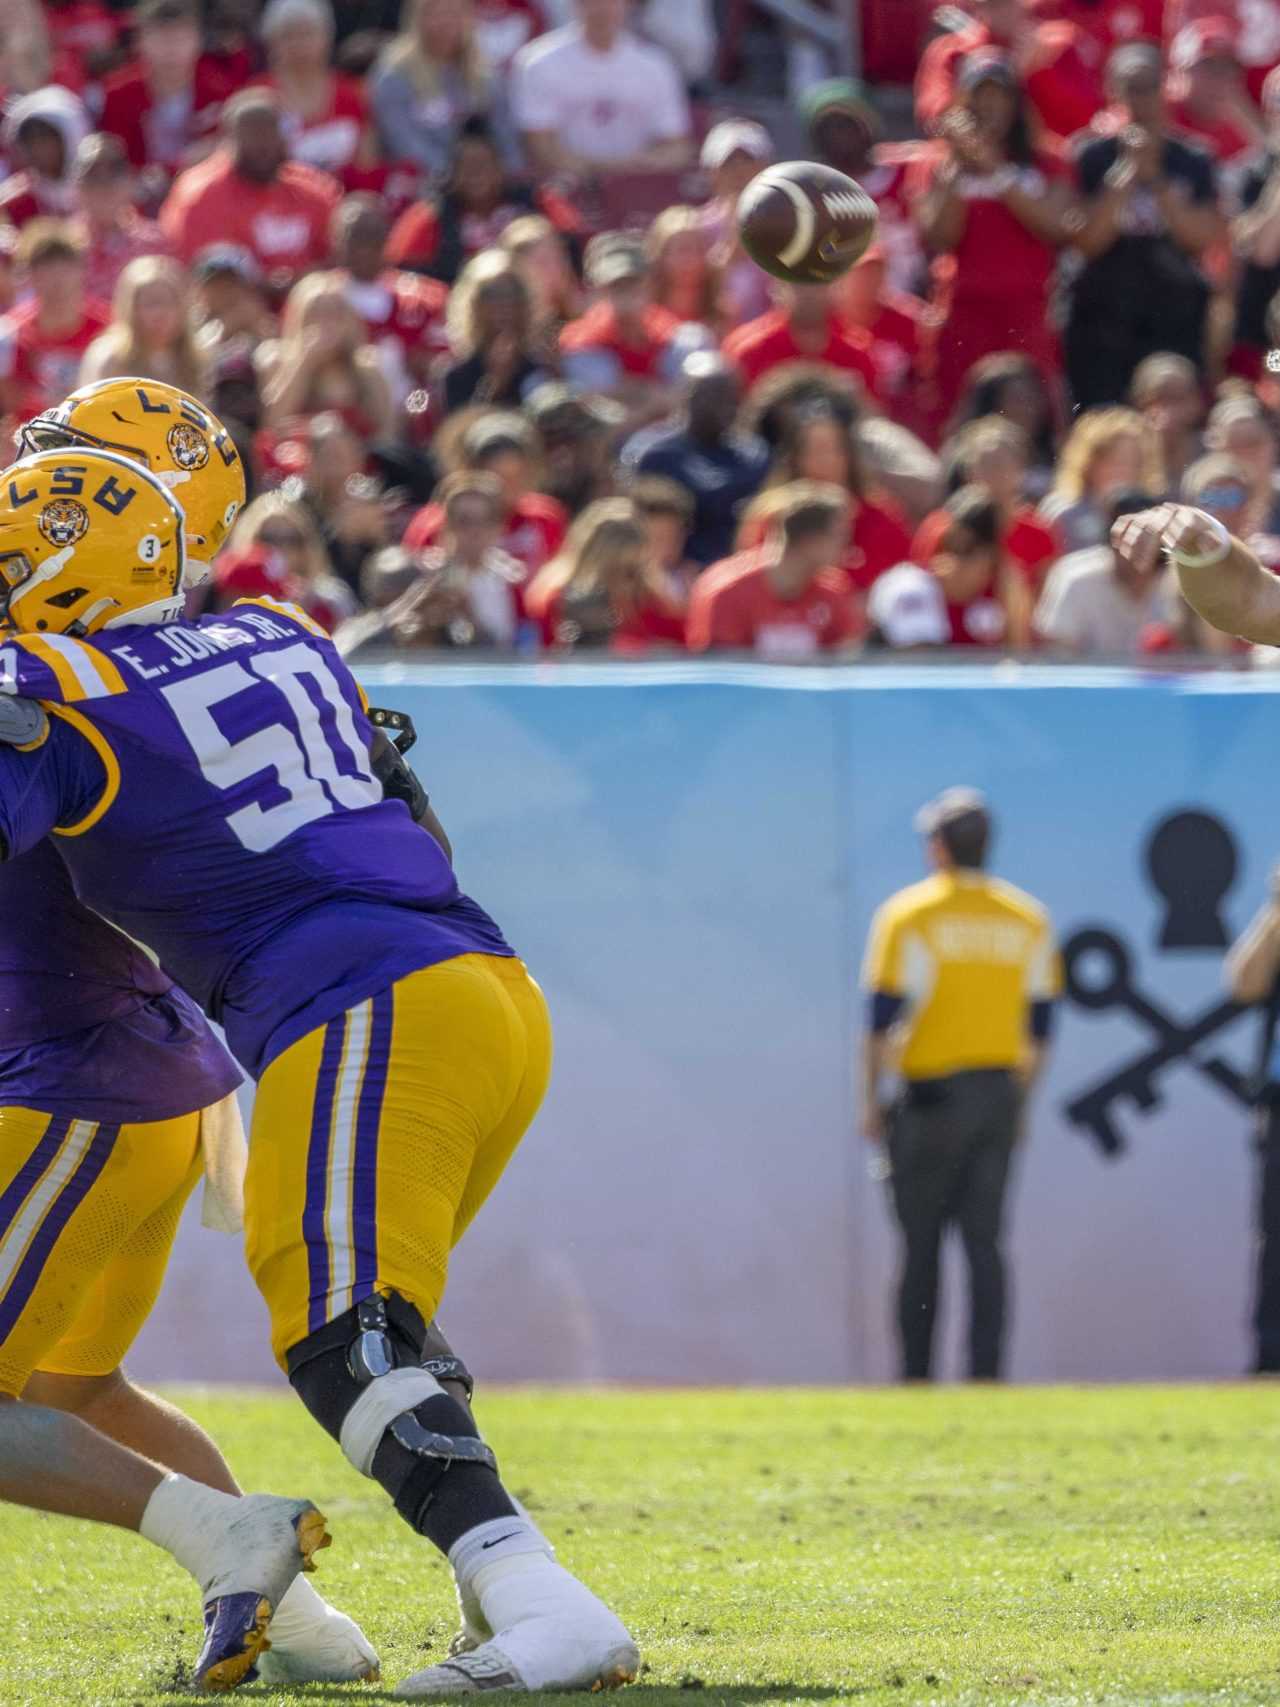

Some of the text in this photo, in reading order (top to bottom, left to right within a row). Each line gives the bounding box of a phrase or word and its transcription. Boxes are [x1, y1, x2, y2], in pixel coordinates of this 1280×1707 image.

[145, 539, 154, 557] 3
[111, 613, 297, 680] E. JONES JR.
[160, 641, 383, 853] 50
